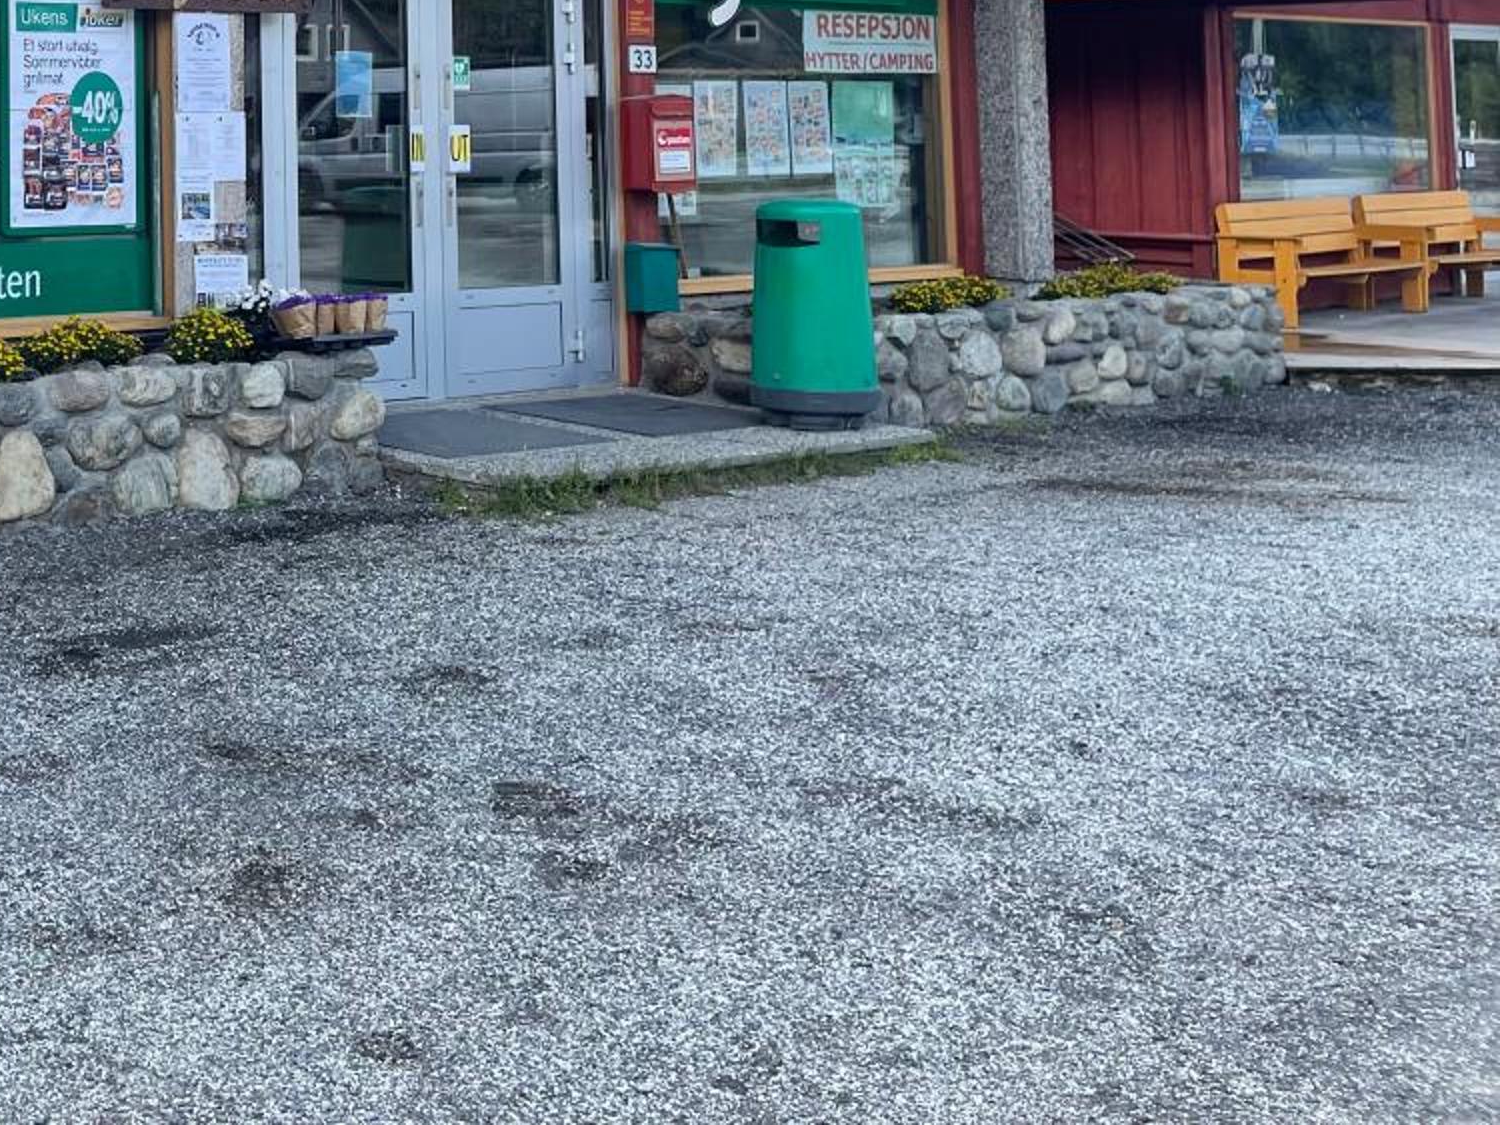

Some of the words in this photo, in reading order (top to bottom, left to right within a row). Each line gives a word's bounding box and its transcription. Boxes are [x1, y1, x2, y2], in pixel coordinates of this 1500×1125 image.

[20, 8, 69, 25] Ukens
[815, 13, 932, 41] RESEPSJON
[633, 48, 654, 69] 33
[72, 90, 119, 125] -40%
[450, 133, 469, 162] UT
